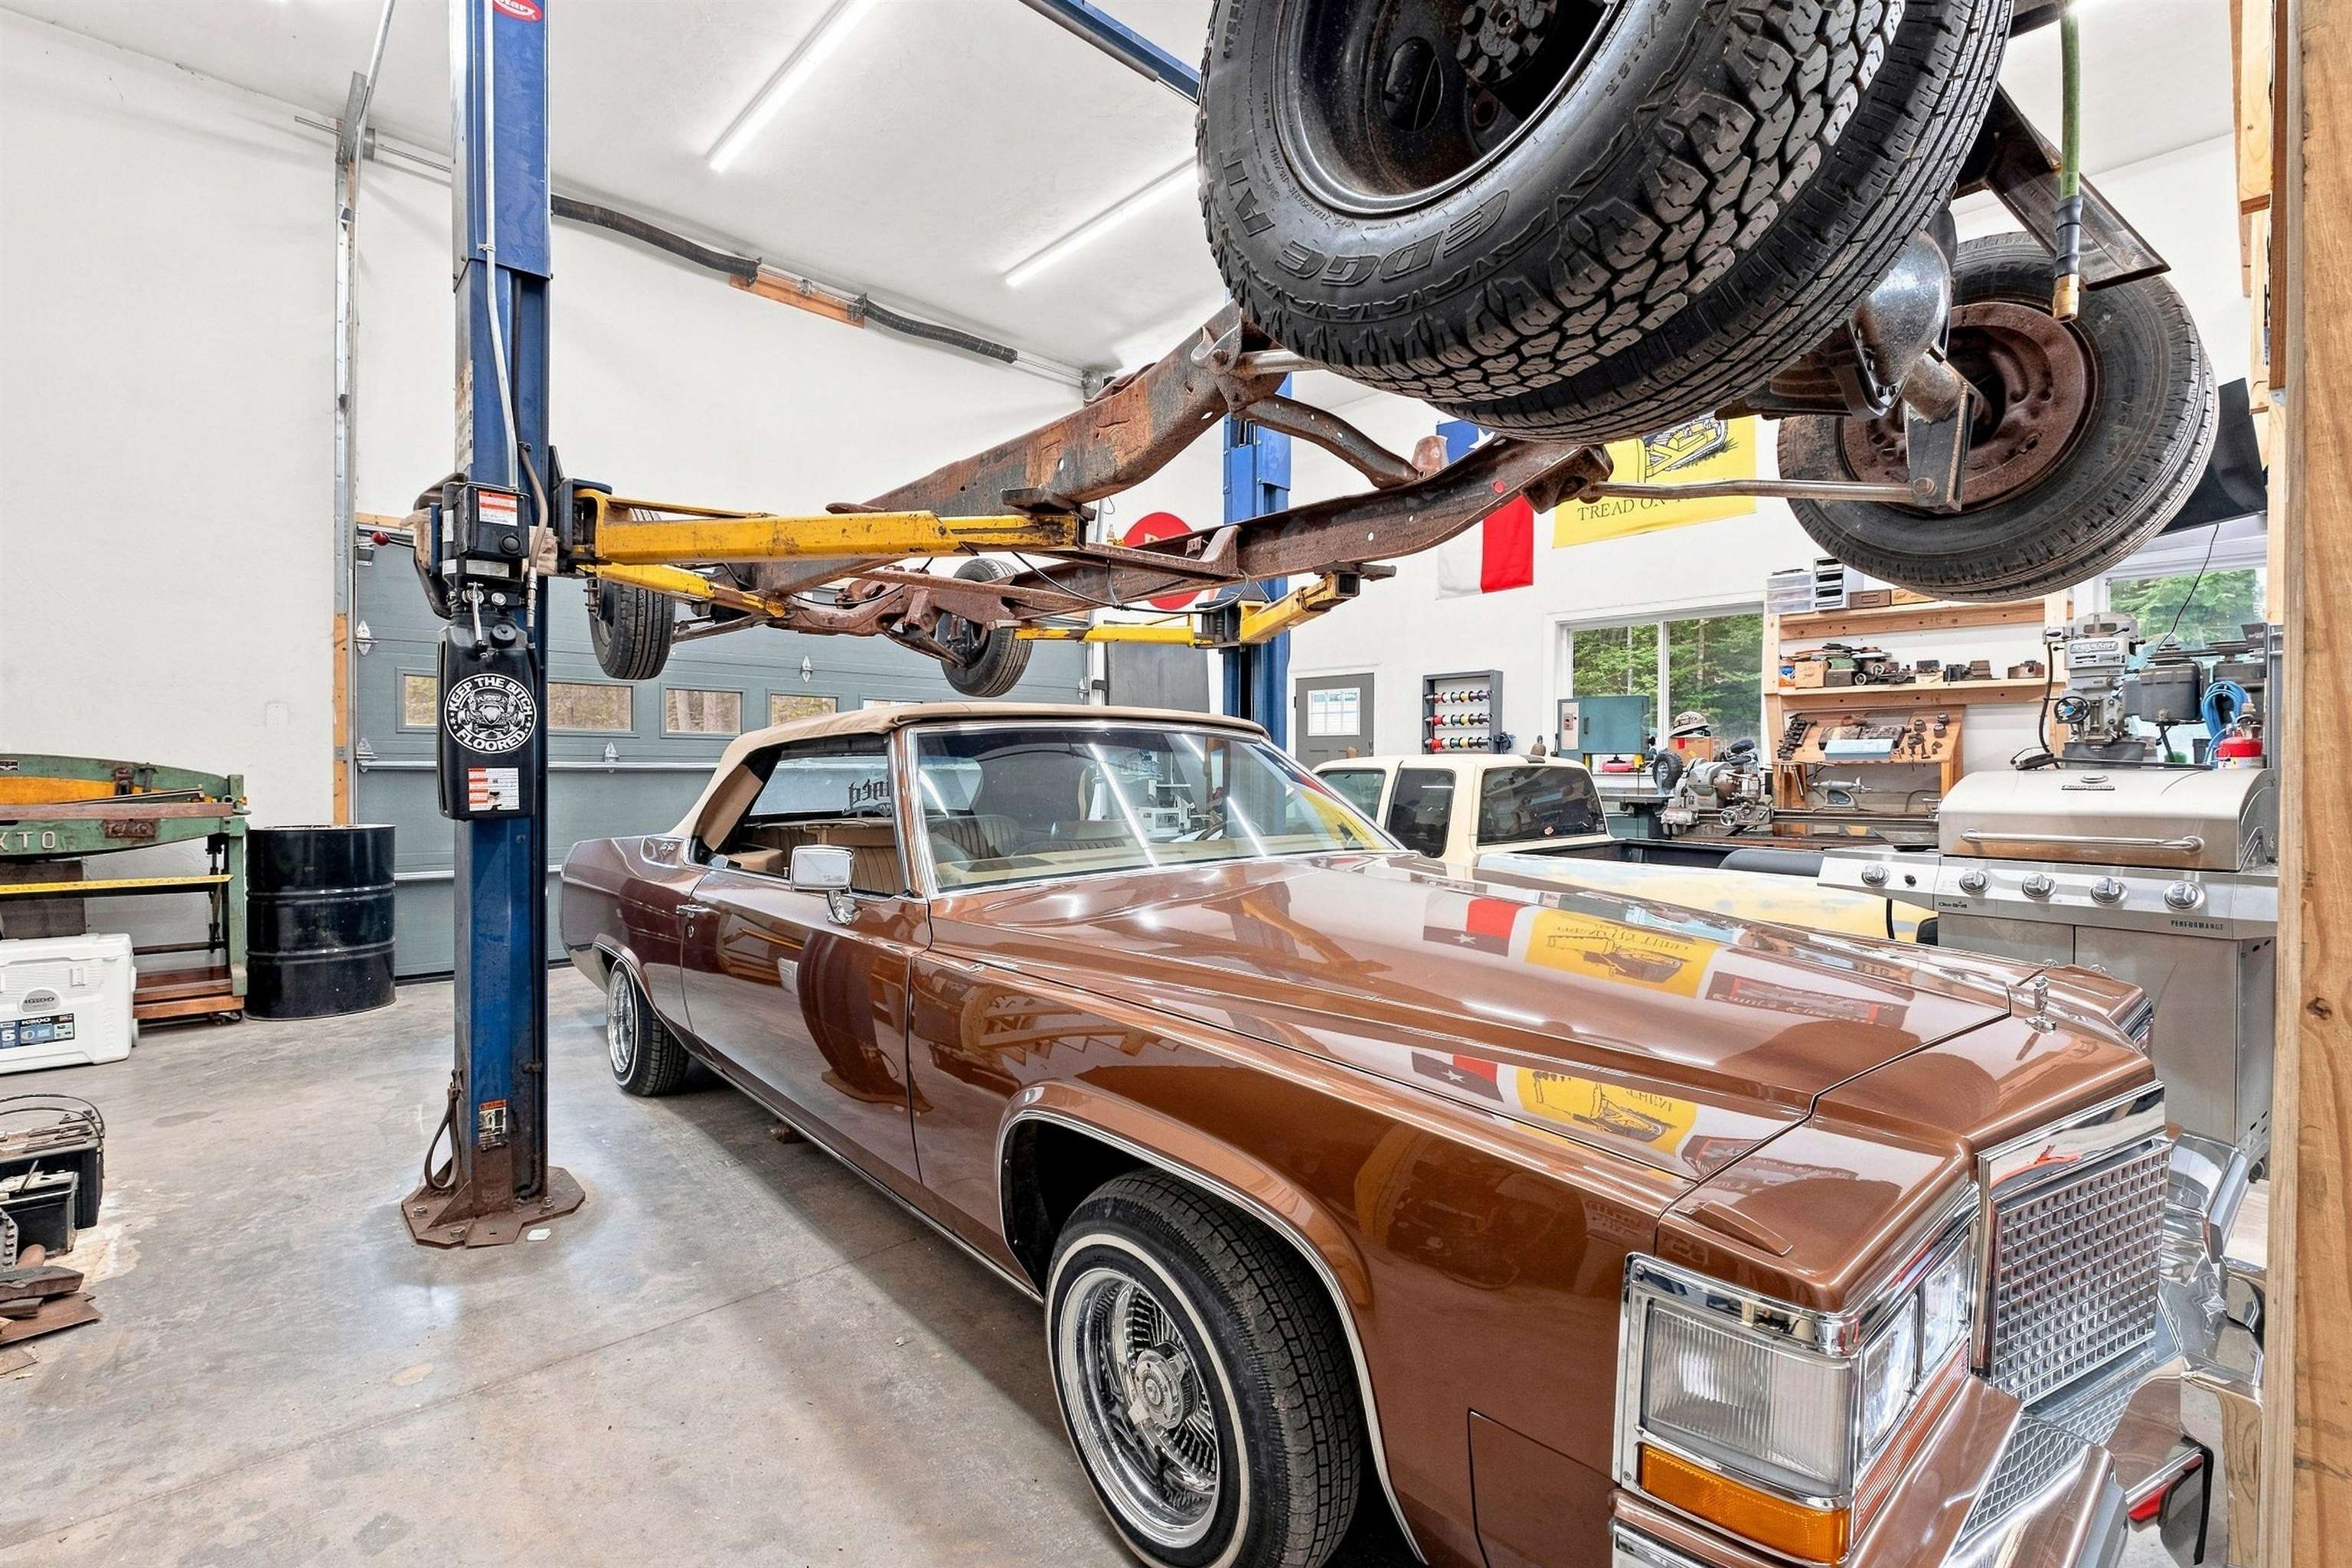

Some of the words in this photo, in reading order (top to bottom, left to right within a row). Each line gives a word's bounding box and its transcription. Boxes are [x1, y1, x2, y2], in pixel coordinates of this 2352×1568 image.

[1275, 189, 1509, 286] EDGE
[1577, 499, 1635, 521] TREAD
[448, 681, 472, 711] KEEP
[474, 677, 505, 688] THE
[506, 681, 533, 715] BITCH
[456, 729, 526, 750] FLOORED
[2171, 920, 2224, 931] PERFORMANCE
